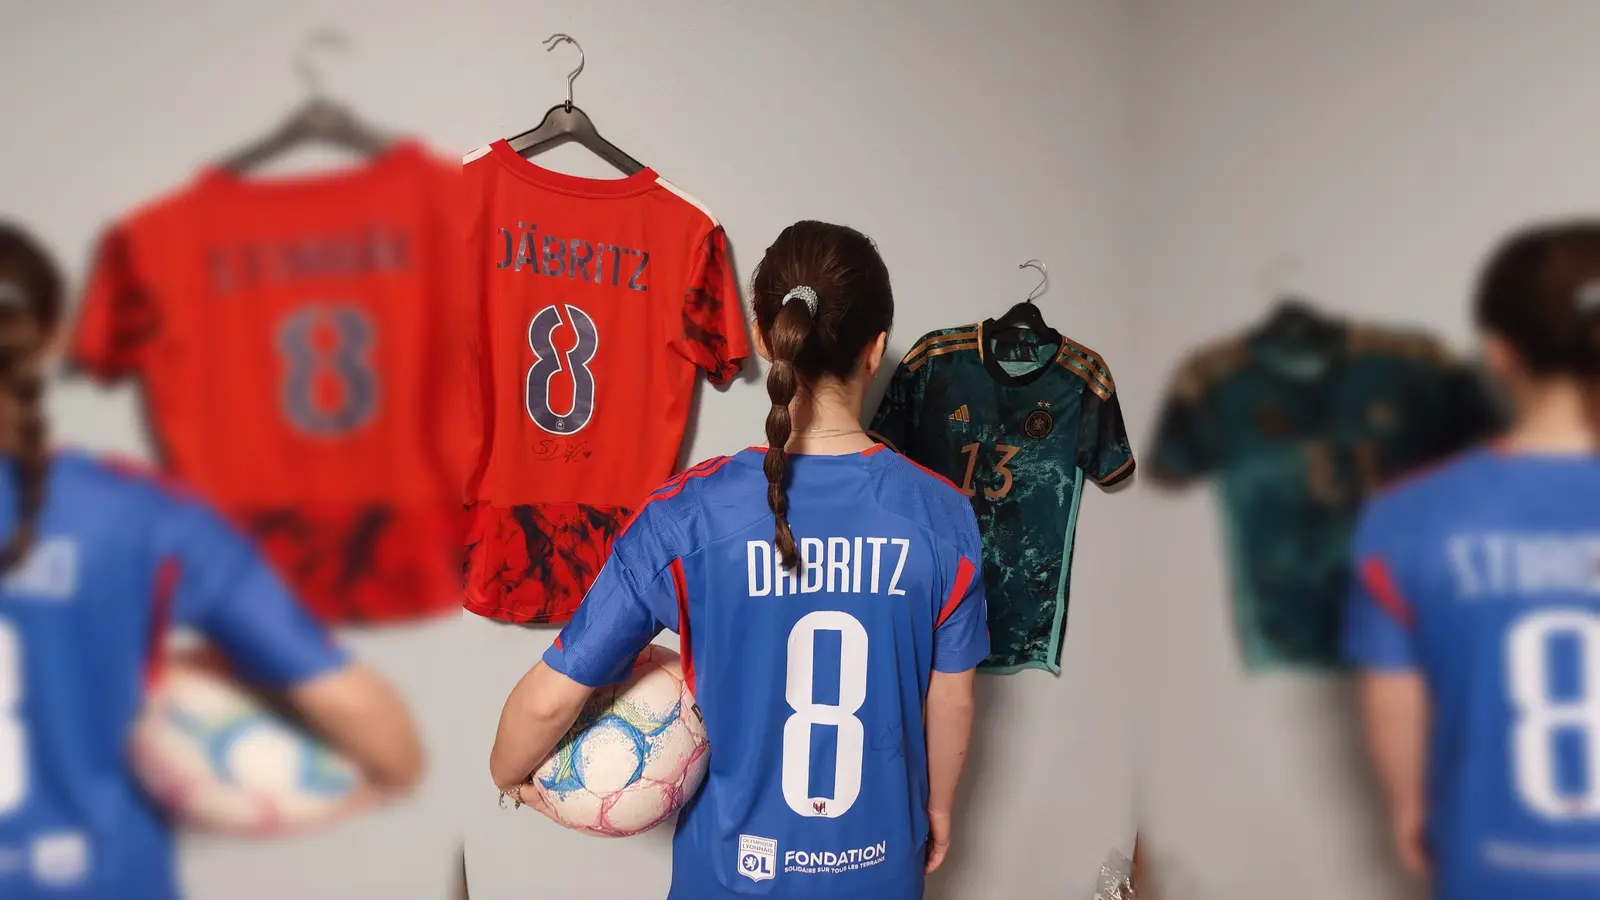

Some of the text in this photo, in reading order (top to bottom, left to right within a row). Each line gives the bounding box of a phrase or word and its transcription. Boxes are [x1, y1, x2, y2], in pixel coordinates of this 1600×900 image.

[526, 303, 599, 436] 8
[961, 442, 1020, 499] 13
[782, 610, 868, 818] 8
[784, 866, 816, 874] SOLIDAIRE
[785, 840, 886, 867] FONDATION
